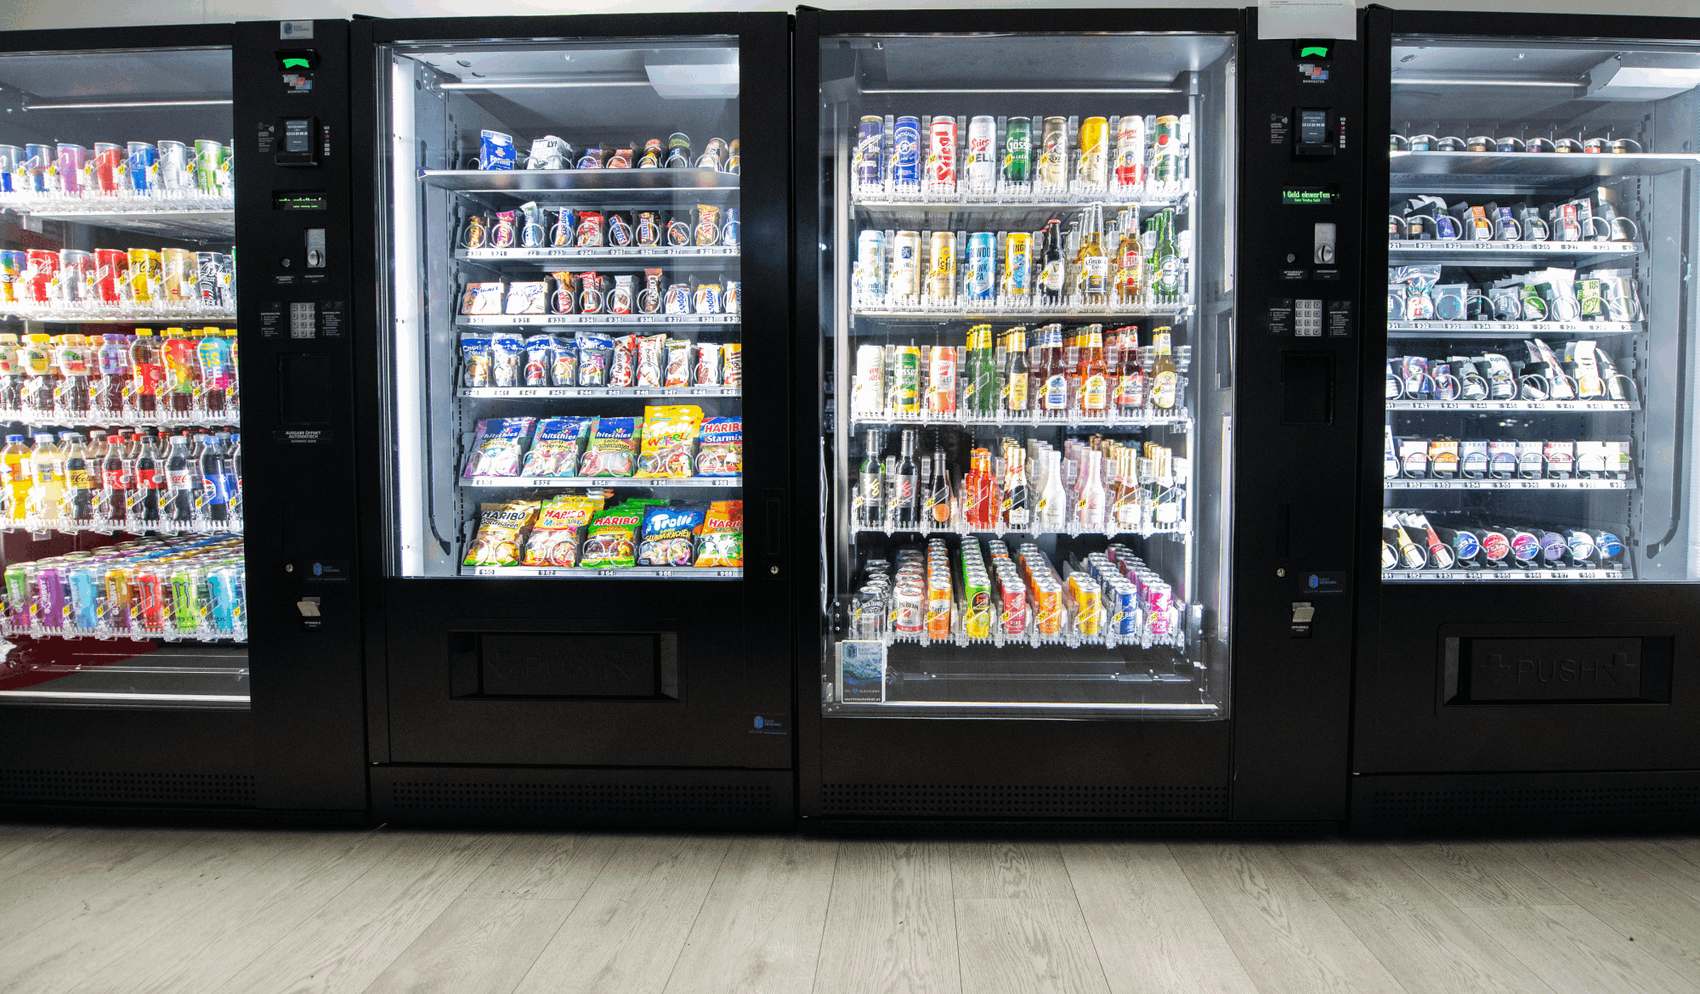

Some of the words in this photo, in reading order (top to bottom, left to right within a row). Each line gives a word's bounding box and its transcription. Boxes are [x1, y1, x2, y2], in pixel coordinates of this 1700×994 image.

[482, 511, 526, 520] HARIBO
[594, 516, 639, 526] HARIBO
[651, 513, 694, 531] Trolli
[1517, 657, 1600, 685] PUSH
